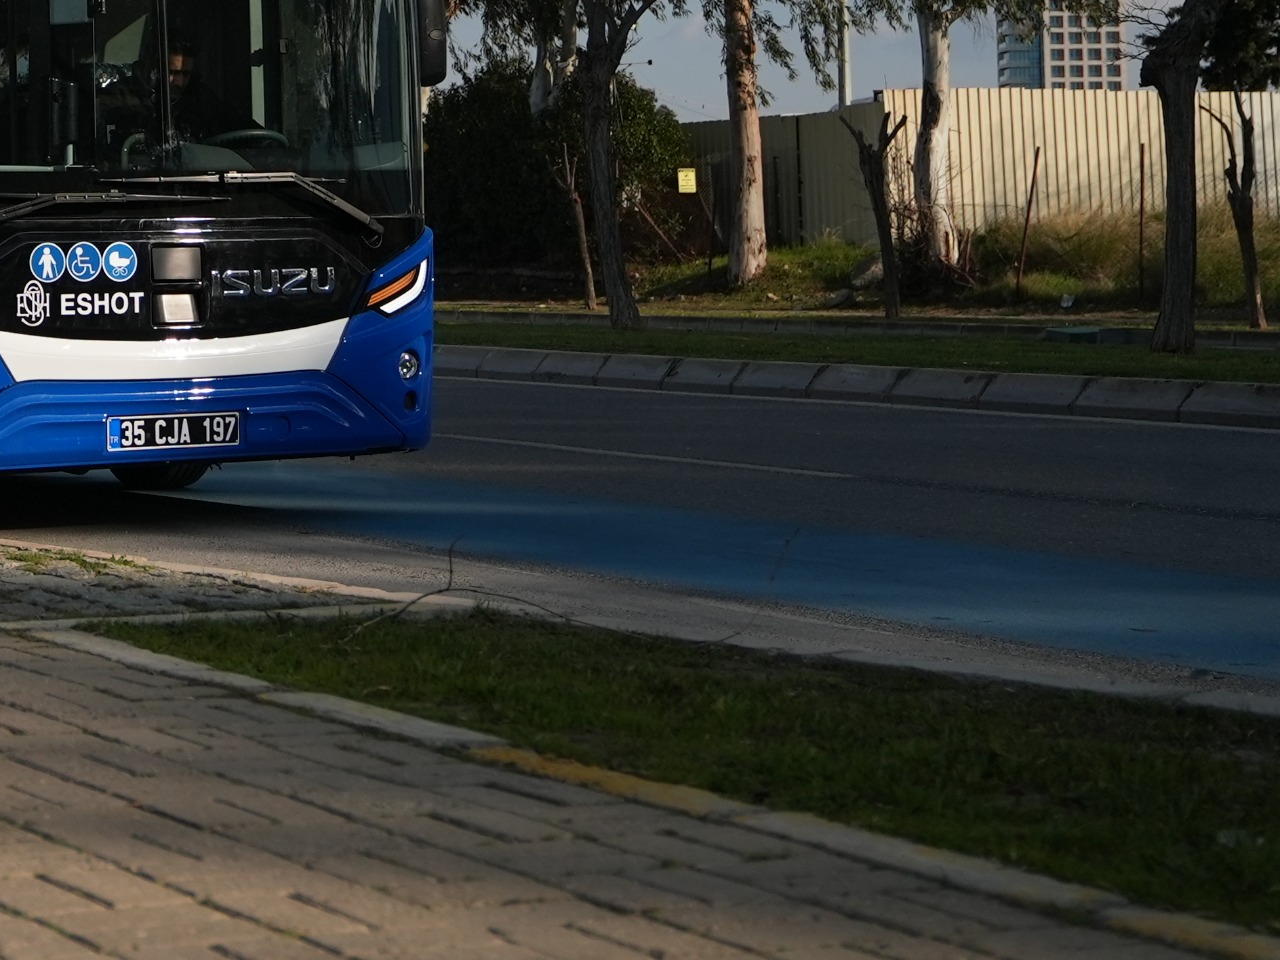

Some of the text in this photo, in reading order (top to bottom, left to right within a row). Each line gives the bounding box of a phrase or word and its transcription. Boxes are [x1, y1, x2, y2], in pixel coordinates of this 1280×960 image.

[210, 266, 336, 297] ISUZU
[60, 291, 145, 316] ESHOT
[110, 416, 236, 447] TR 35 CJA 197
